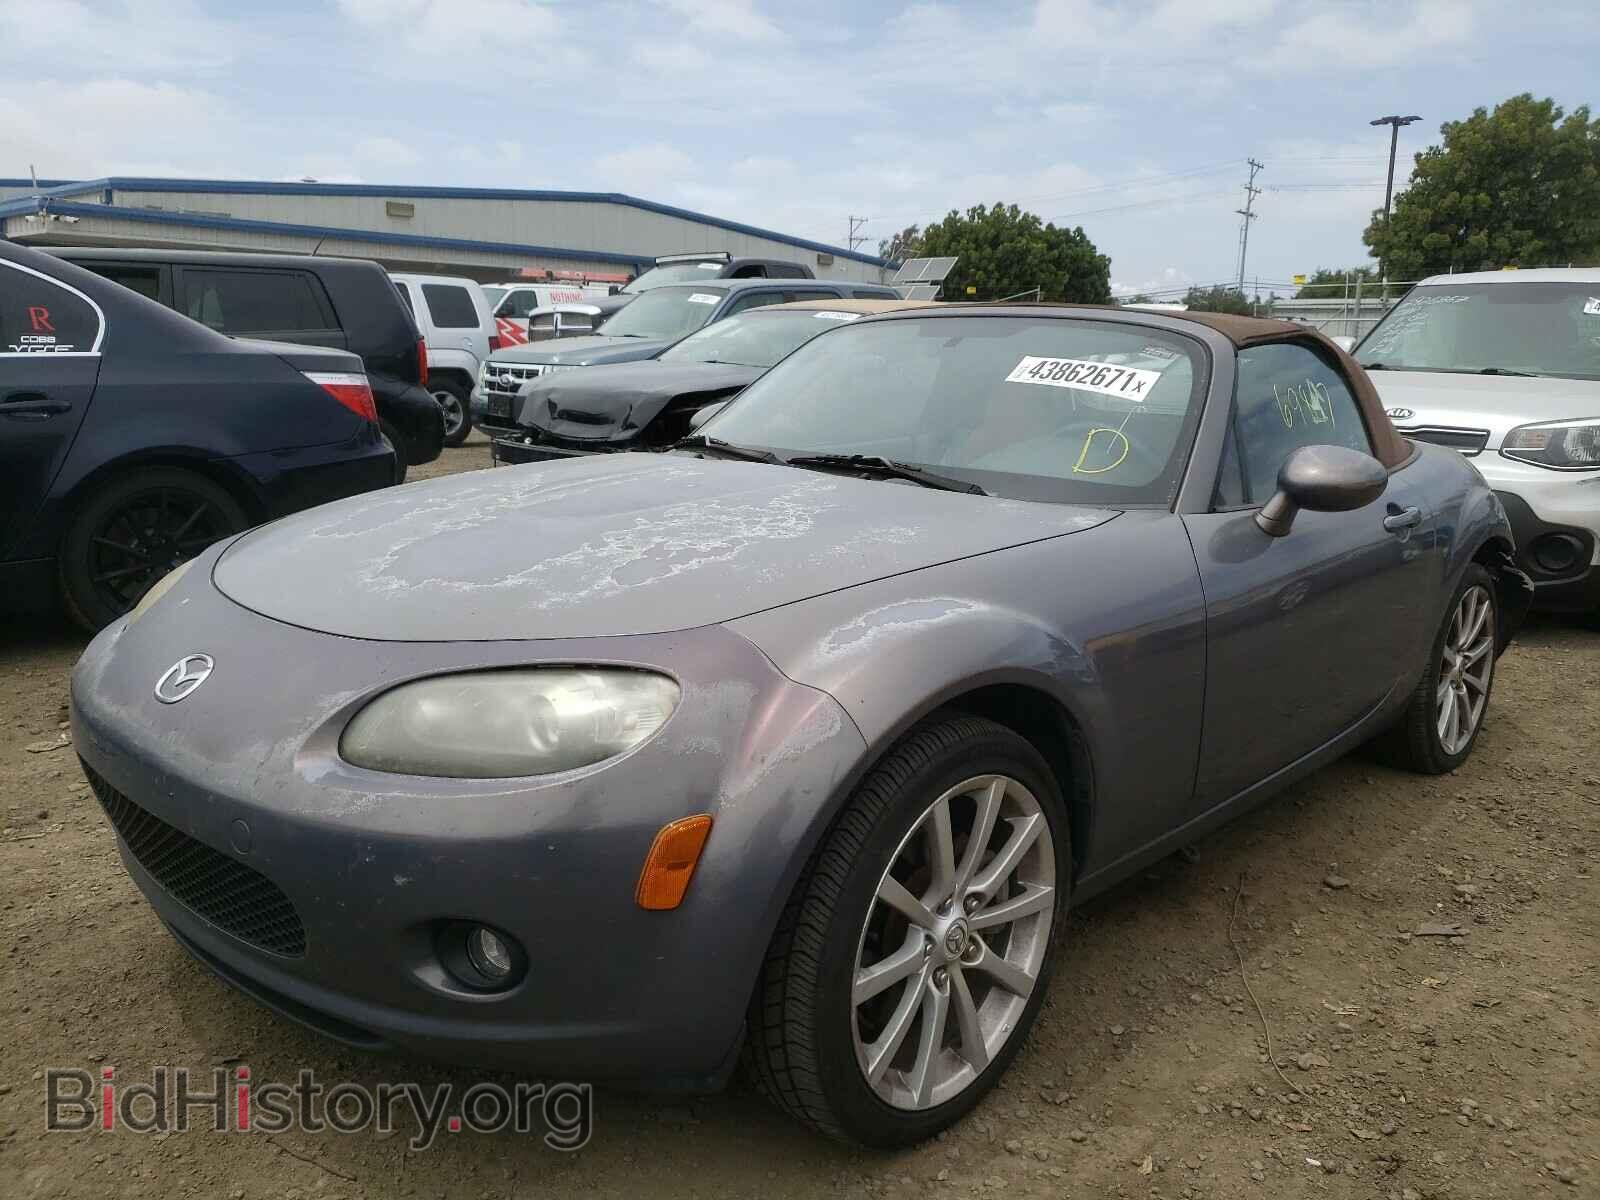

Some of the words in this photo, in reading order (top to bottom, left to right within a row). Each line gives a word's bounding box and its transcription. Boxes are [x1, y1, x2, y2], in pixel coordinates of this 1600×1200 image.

[27, 305, 56, 331] R
[20, 335, 56, 343] COBB
[1028, 360, 1137, 392] 43862671
[1072, 428, 1129, 474] D
